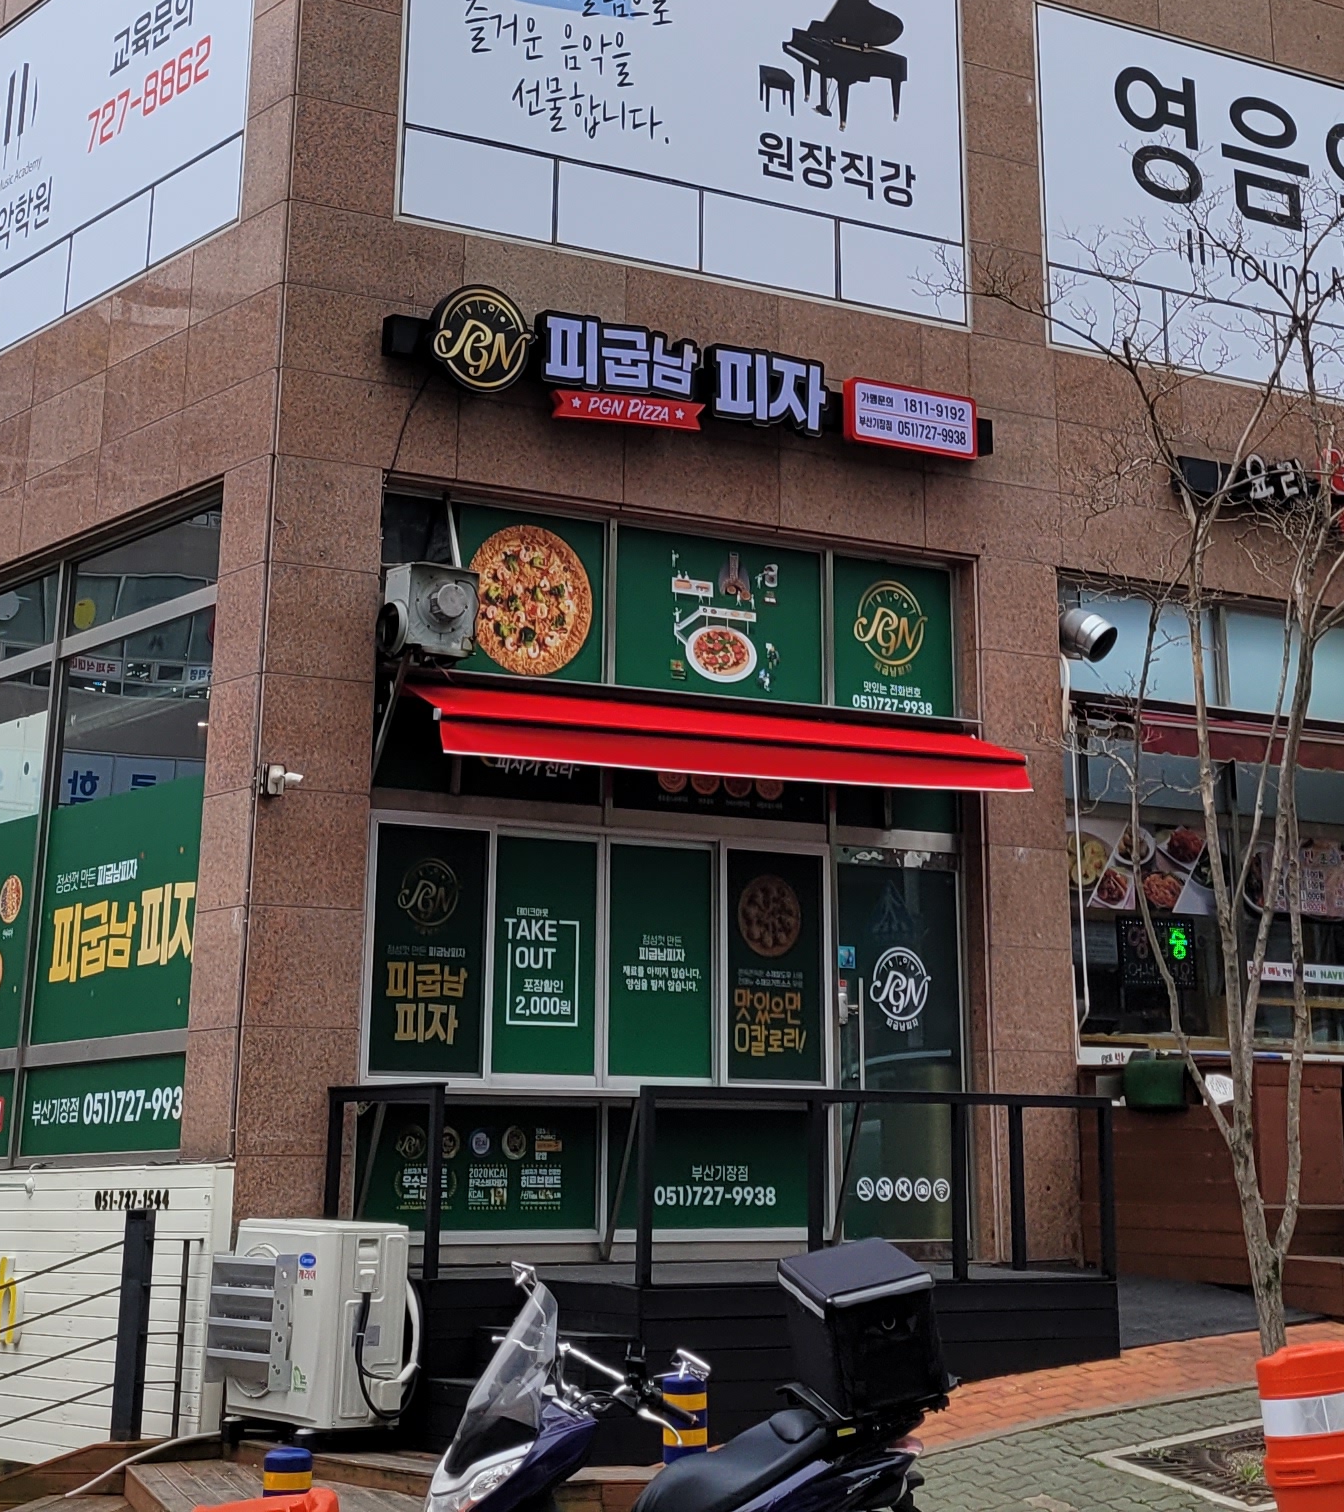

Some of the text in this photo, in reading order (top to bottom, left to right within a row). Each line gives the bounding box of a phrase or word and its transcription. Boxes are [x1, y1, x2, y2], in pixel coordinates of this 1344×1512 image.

[559, 22, 634, 88] 음악을
[87, 34, 213, 154] 727-8862
[512, 76, 671, 145] 선물합니다.
[756, 131, 917, 209] 원장직강
[544, 315, 828, 431] 피굽남 피자
[587, 397, 624, 417] PGN
[860, 391, 966, 422] 가맹문의 1811-9192
[858, 415, 967, 445] 부산기장점 051)727-9938
[863, 680, 922, 698] 맛있는 전화번호
[852, 694, 933, 716] 051)727-9938
[96, 857, 138, 885] 피굽남피자
[48, 900, 138, 984] 피굽남
[504, 917, 558, 942] TAKE
[515, 946, 556, 970] OUT
[638, 947, 686, 962] 피굽남피자
[385, 960, 469, 999] 피굽남
[523, 979, 564, 994] 포장할인
[515, 996, 571, 1016] 2,000원
[734, 988, 801, 1025] 맛있으면
[394, 1002, 459, 1045] 피자
[31, 1095, 81, 1127] 부산기장점
[690, 1163, 750, 1184] 부산기장점
[653, 1184, 777, 1209] 051)727-9938
